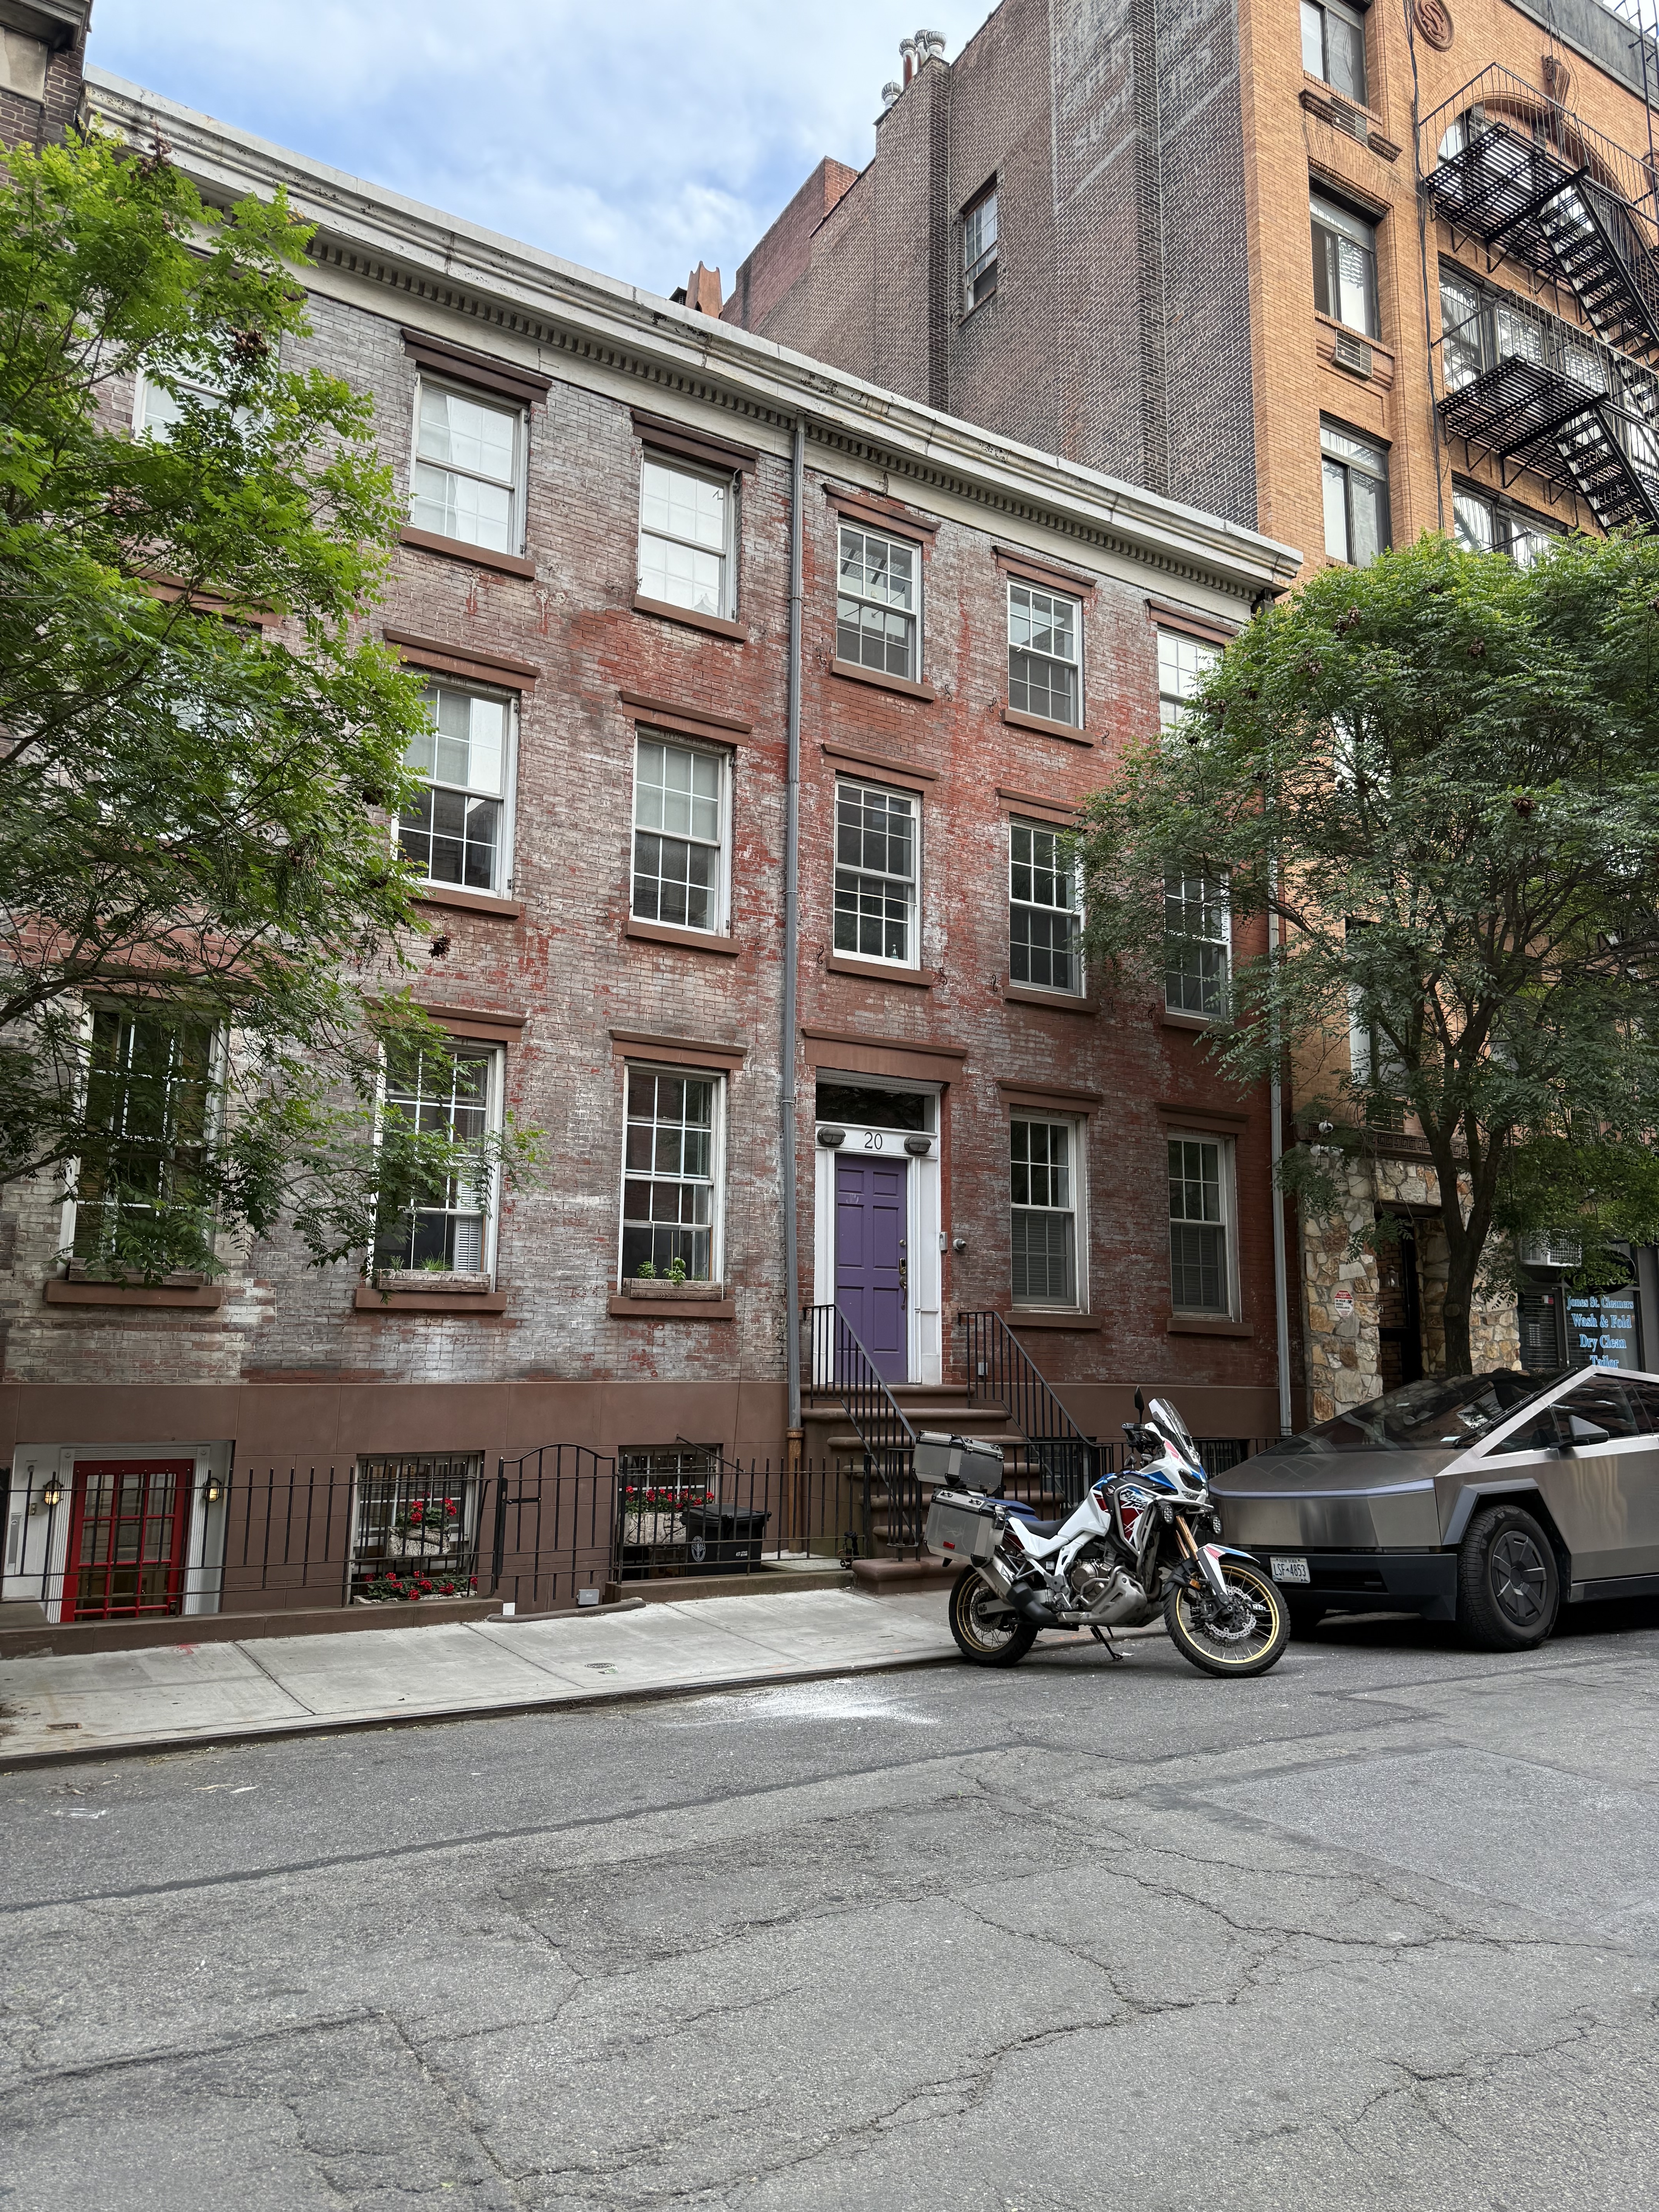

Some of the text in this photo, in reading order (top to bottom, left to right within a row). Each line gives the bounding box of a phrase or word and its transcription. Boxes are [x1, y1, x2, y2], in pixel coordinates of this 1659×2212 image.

[864, 1132, 883, 1150] 20
[1566, 1295, 1634, 1310] Jones St. Cleaners
[1571, 1313, 1632, 1328] Wash & Fold
[1579, 1334, 1626, 1352] Dry Clean
[1589, 1355, 1619, 1369] Tailor
